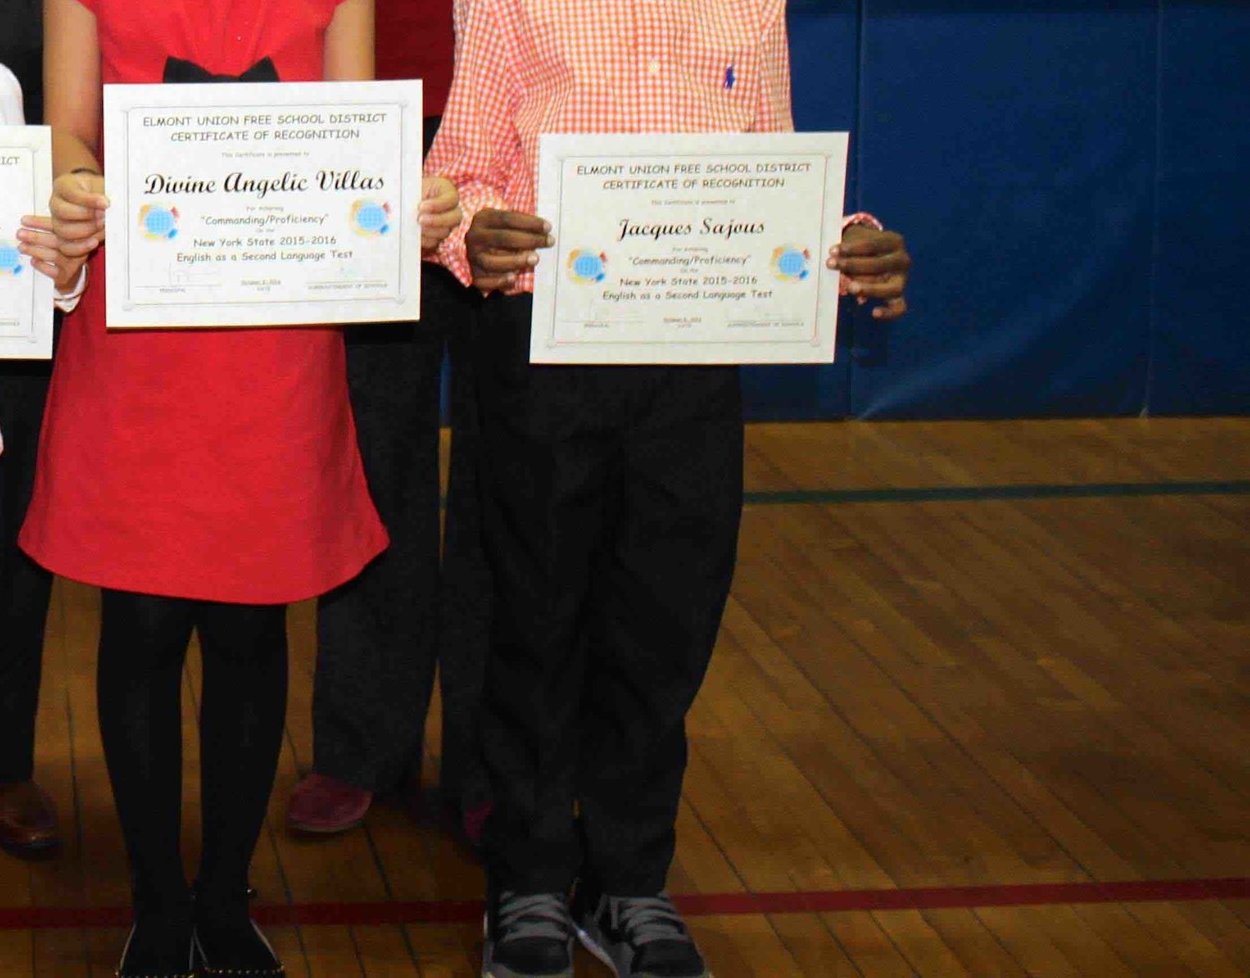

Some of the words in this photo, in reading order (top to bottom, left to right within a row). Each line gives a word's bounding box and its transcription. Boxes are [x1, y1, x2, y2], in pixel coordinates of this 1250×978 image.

[143, 117, 192, 127] ELMONT
[197, 116, 239, 125] UNION
[244, 115, 272, 125] FREE
[277, 114, 325, 124] SCHOOL
[330, 113, 387, 123] DISTRICT
[171, 131, 249, 142] CERTIFICATE
[254, 130, 269, 140] OF
[275, 129, 360, 140] RECOGNITION
[577, 165, 624, 175] ELMONT
[629, 164, 670, 174] UNION
[674, 164, 701, 173] FREE
[706, 164, 752, 172] SCHOOL
[756, 162, 811, 172] DISTRICT
[144, 173, 216, 195] Divine
[224, 171, 309, 198] Angelic
[316, 170, 385, 192] Villas
[603, 180, 679, 189] CERTIFICATE
[683, 179, 697, 188] OF
[702, 178, 785, 188] RECOGNITION
[617, 219, 693, 242] Jacques
[700, 218, 764, 239] Sajous
[194, 238, 216, 248] New
[220, 237, 242, 247] York
[248, 236, 275, 246] State
[280, 235, 337, 245] 2015-2016
[177, 252, 211, 263] English
[216, 253, 228, 261] as
[242, 250, 277, 260] Second
[281, 251, 326, 262] Language
[331, 249, 353, 259] Test
[620, 277, 641, 286] New
[646, 277, 667, 286] York
[671, 276, 698, 285] State
[703, 276, 757, 285] 2015-2016
[603, 291, 637, 300] English
[666, 291, 699, 299] Second
[703, 290, 746, 300] Language
[752, 290, 772, 298] Test
